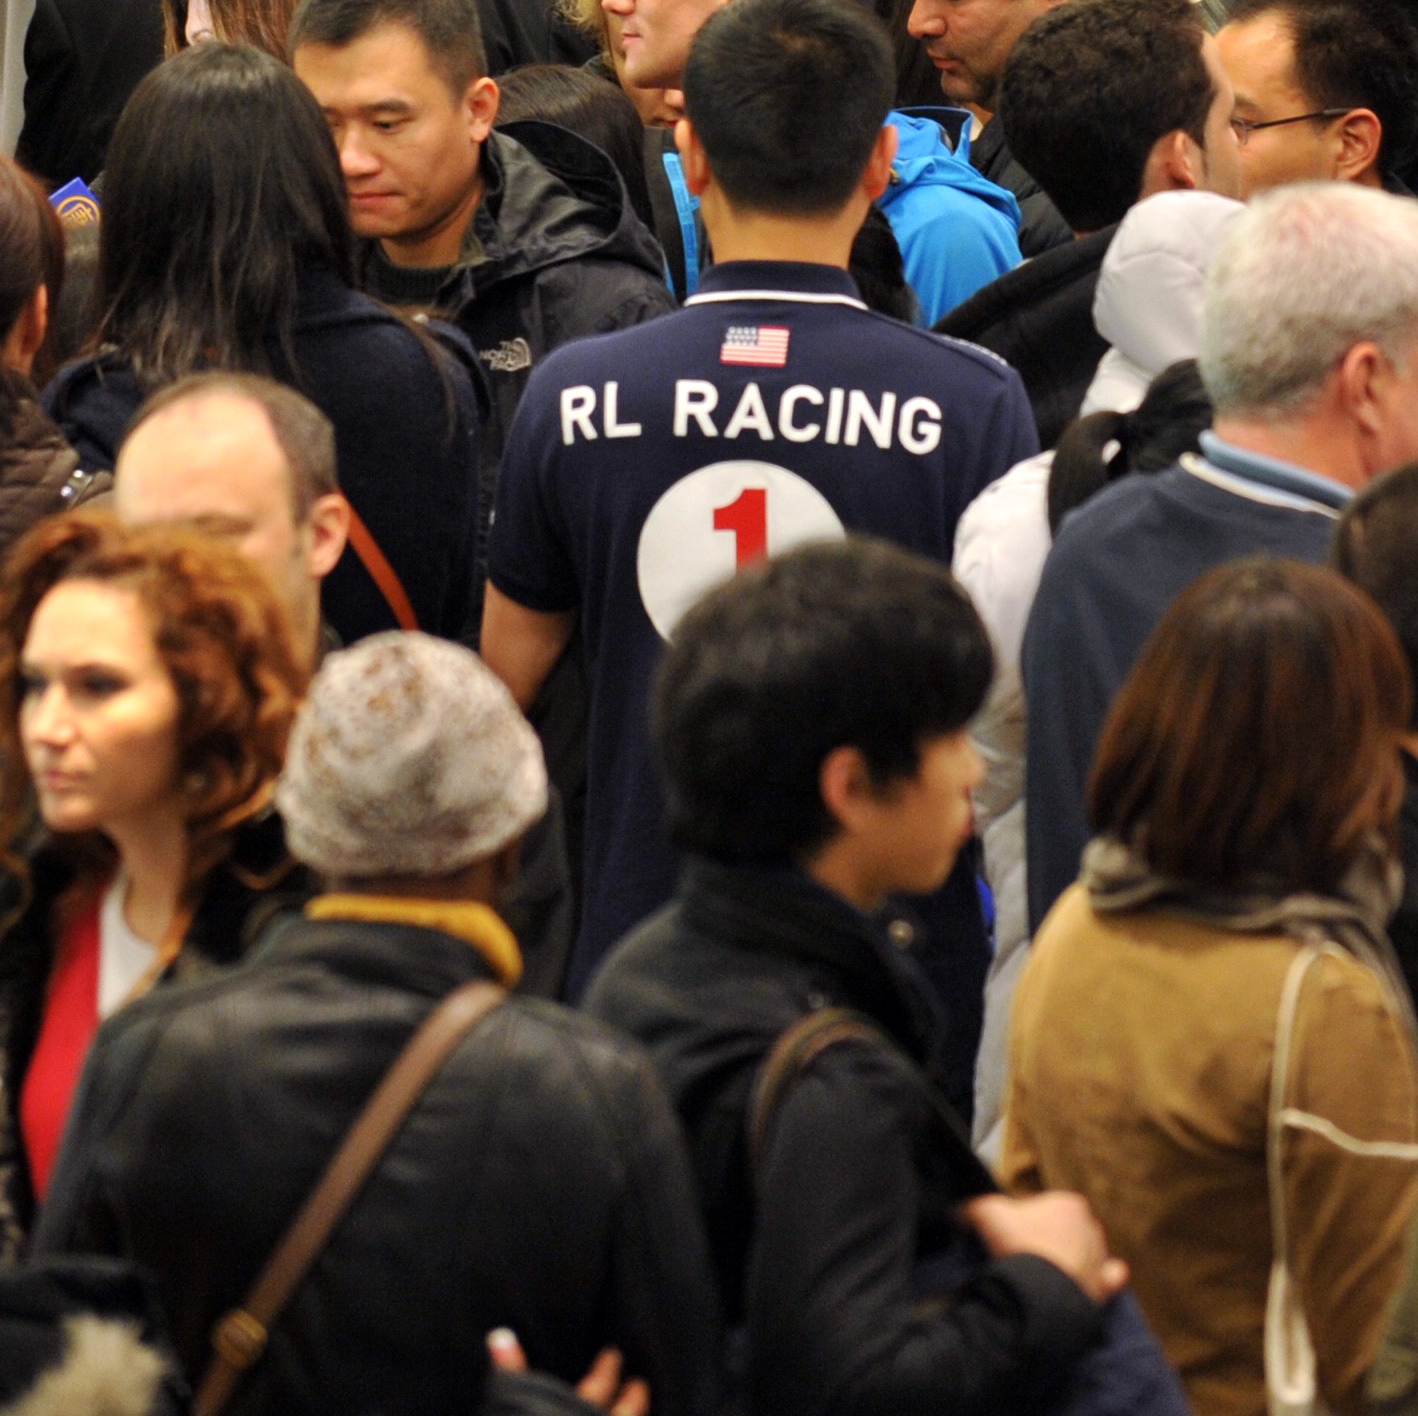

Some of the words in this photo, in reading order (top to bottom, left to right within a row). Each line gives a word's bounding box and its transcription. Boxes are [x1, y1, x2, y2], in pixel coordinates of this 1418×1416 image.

[560, 380, 643, 446] RL
[673, 379, 943, 455] RACING
[712, 488, 769, 577] 1
